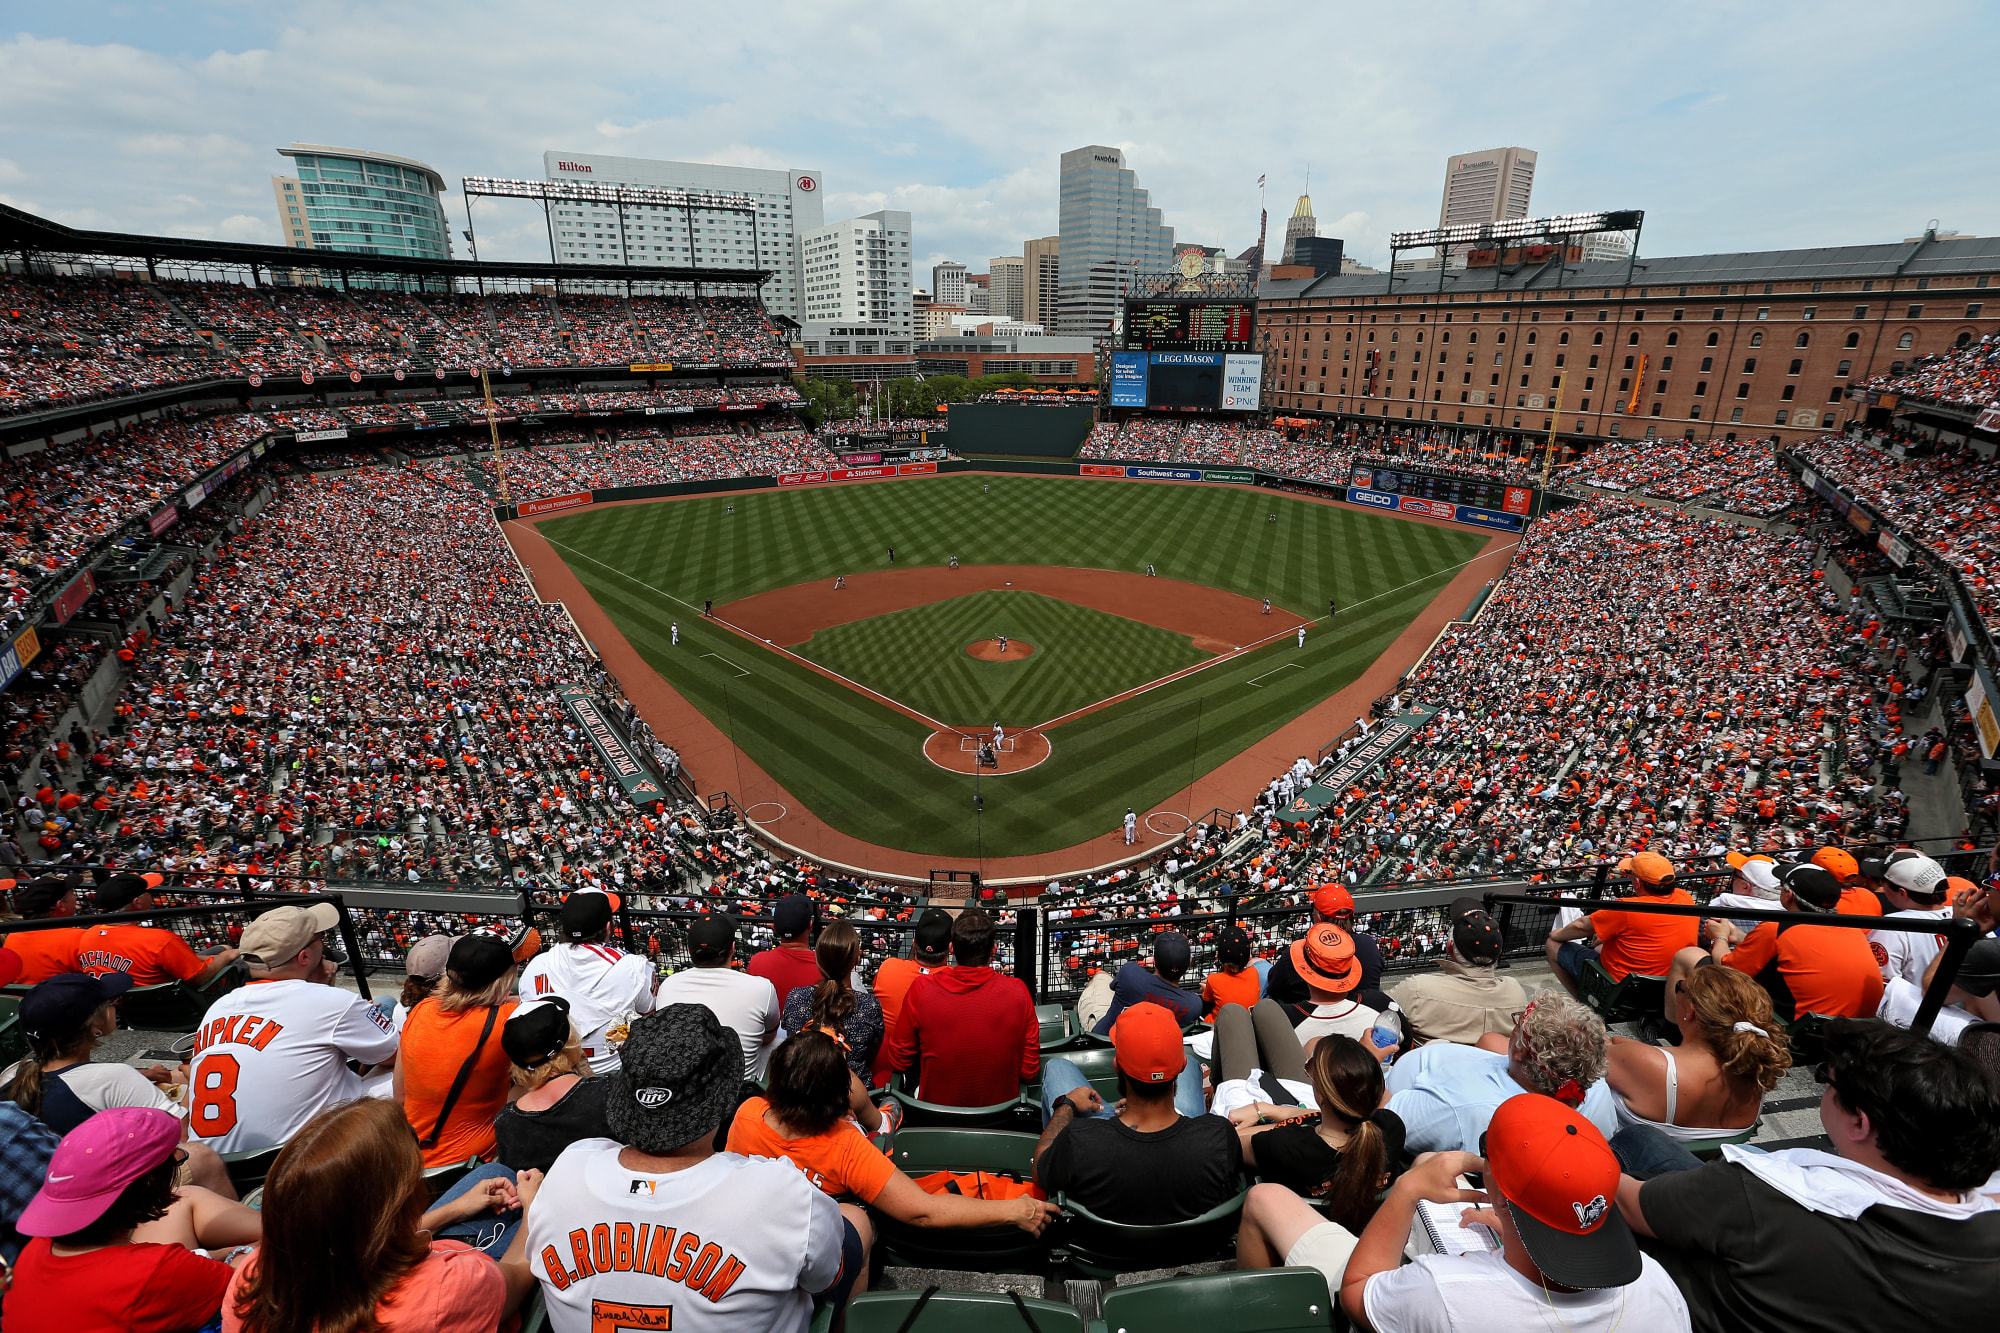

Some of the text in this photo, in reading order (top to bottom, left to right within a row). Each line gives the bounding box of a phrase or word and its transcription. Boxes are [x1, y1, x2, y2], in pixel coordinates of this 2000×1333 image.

[1094, 154, 1118, 162] PANDORA
[558, 162, 592, 173] Hilton
[1145, 281, 1238, 292] THE SUN
[1159, 355, 1215, 364] LEGG MASON
[1228, 376, 1257, 384] WINNING
[1237, 398, 1256, 406] PNC
[1356, 492, 1391, 505] GEICO
[1403, 504, 1430, 512] HORIZON
[1, 648, 19, 679] BAY
[574, 699, 638, 776] WELCOME TO ORIOLE PARK
[1323, 723, 1409, 789] HOME OF THE ORIOLES
[194, 1014, 283, 1057] RIPKEN
[190, 1053, 241, 1138] 8
[541, 1222, 747, 1303] B.ROBINSON
